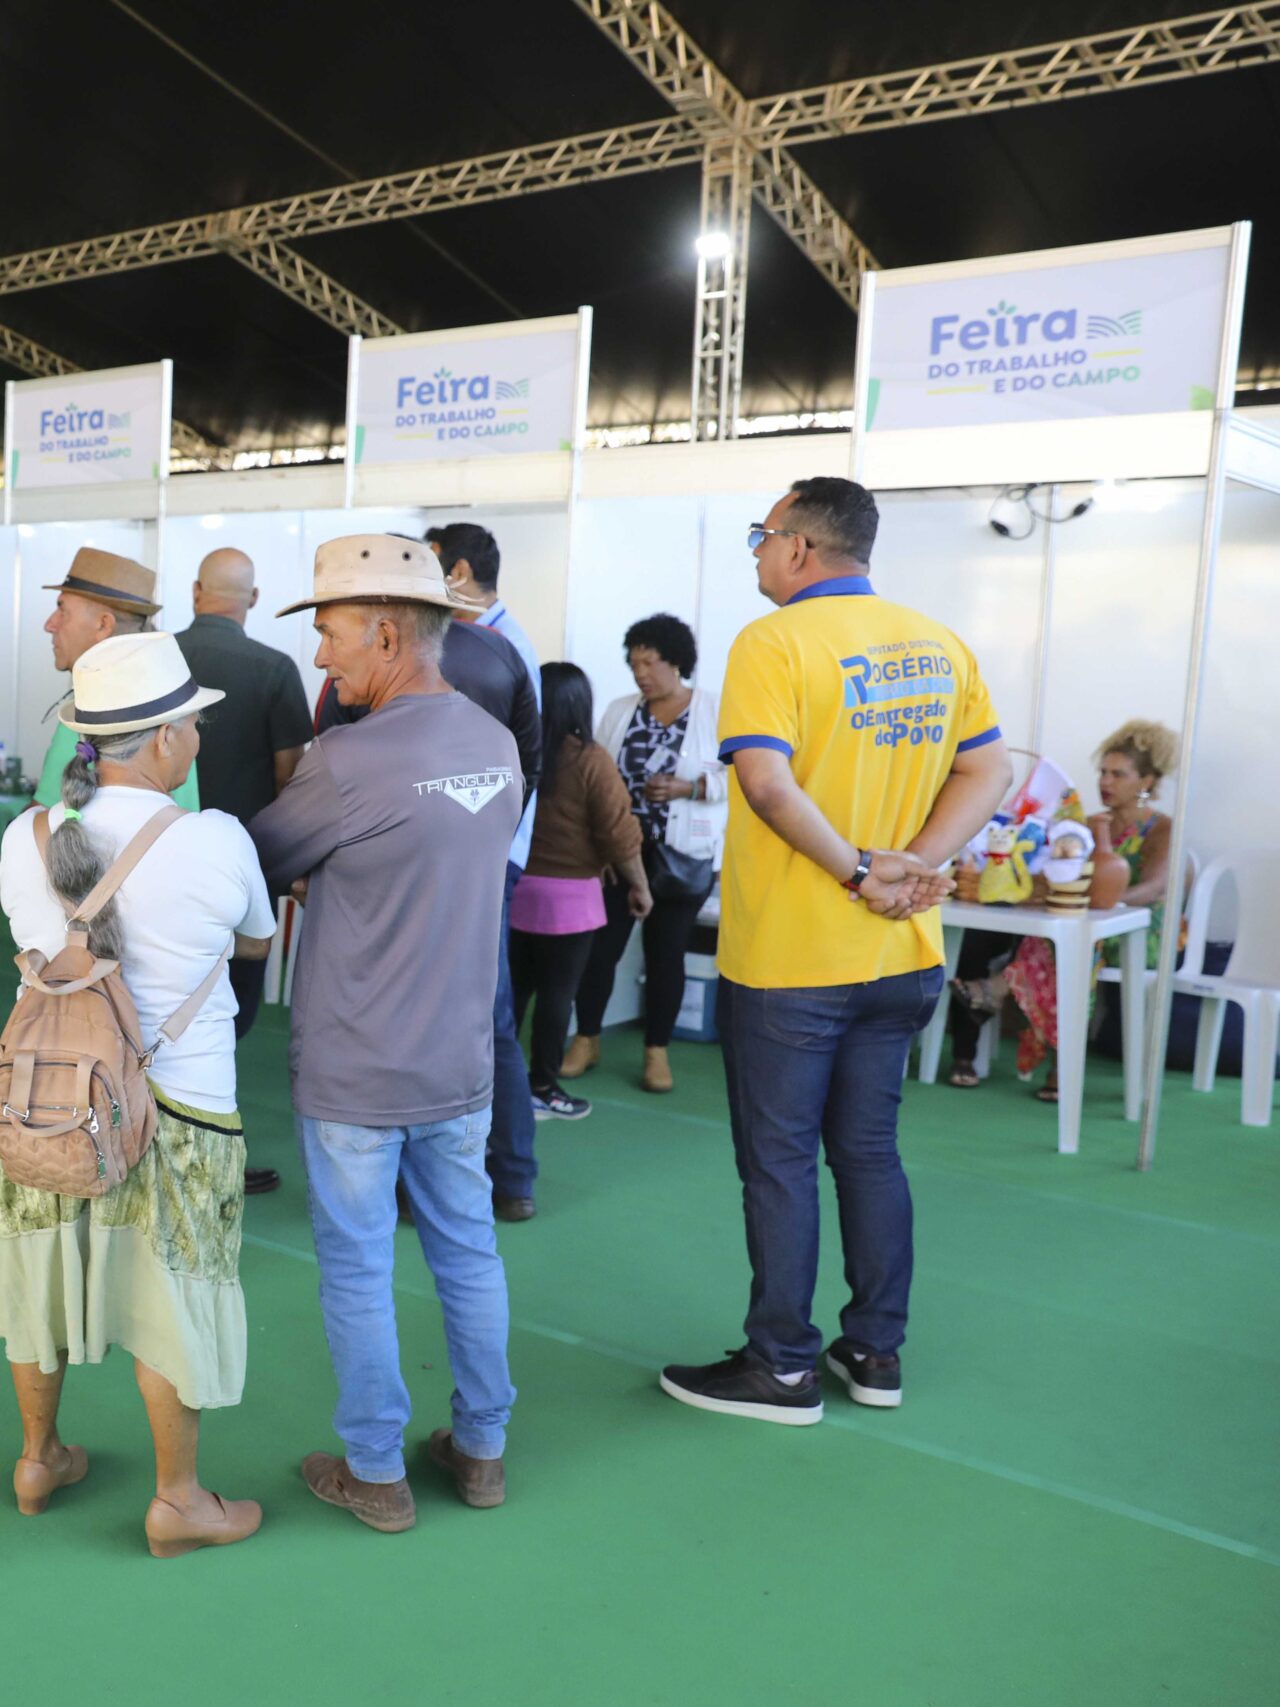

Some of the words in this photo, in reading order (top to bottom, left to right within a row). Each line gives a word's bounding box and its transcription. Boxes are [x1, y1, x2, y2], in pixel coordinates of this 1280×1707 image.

[930, 304, 1078, 356] Feira
[928, 362, 960, 380] DO
[966, 349, 1087, 377] TRABALHO
[397, 371, 490, 409] Feira
[993, 378, 1006, 394] E
[1012, 374, 1046, 393] DO
[1051, 365, 1141, 388] CAMPO
[40, 408, 104, 436] Feira
[395, 414, 417, 427] DO
[420, 407, 496, 424] TRABALHO
[437, 428, 445, 441] E
[449, 427, 470, 439] DO
[474, 422, 529, 437] CAMPO
[840, 653, 952, 704] ROGÉRIO
[412, 771, 514, 796] TRIANGULAR
